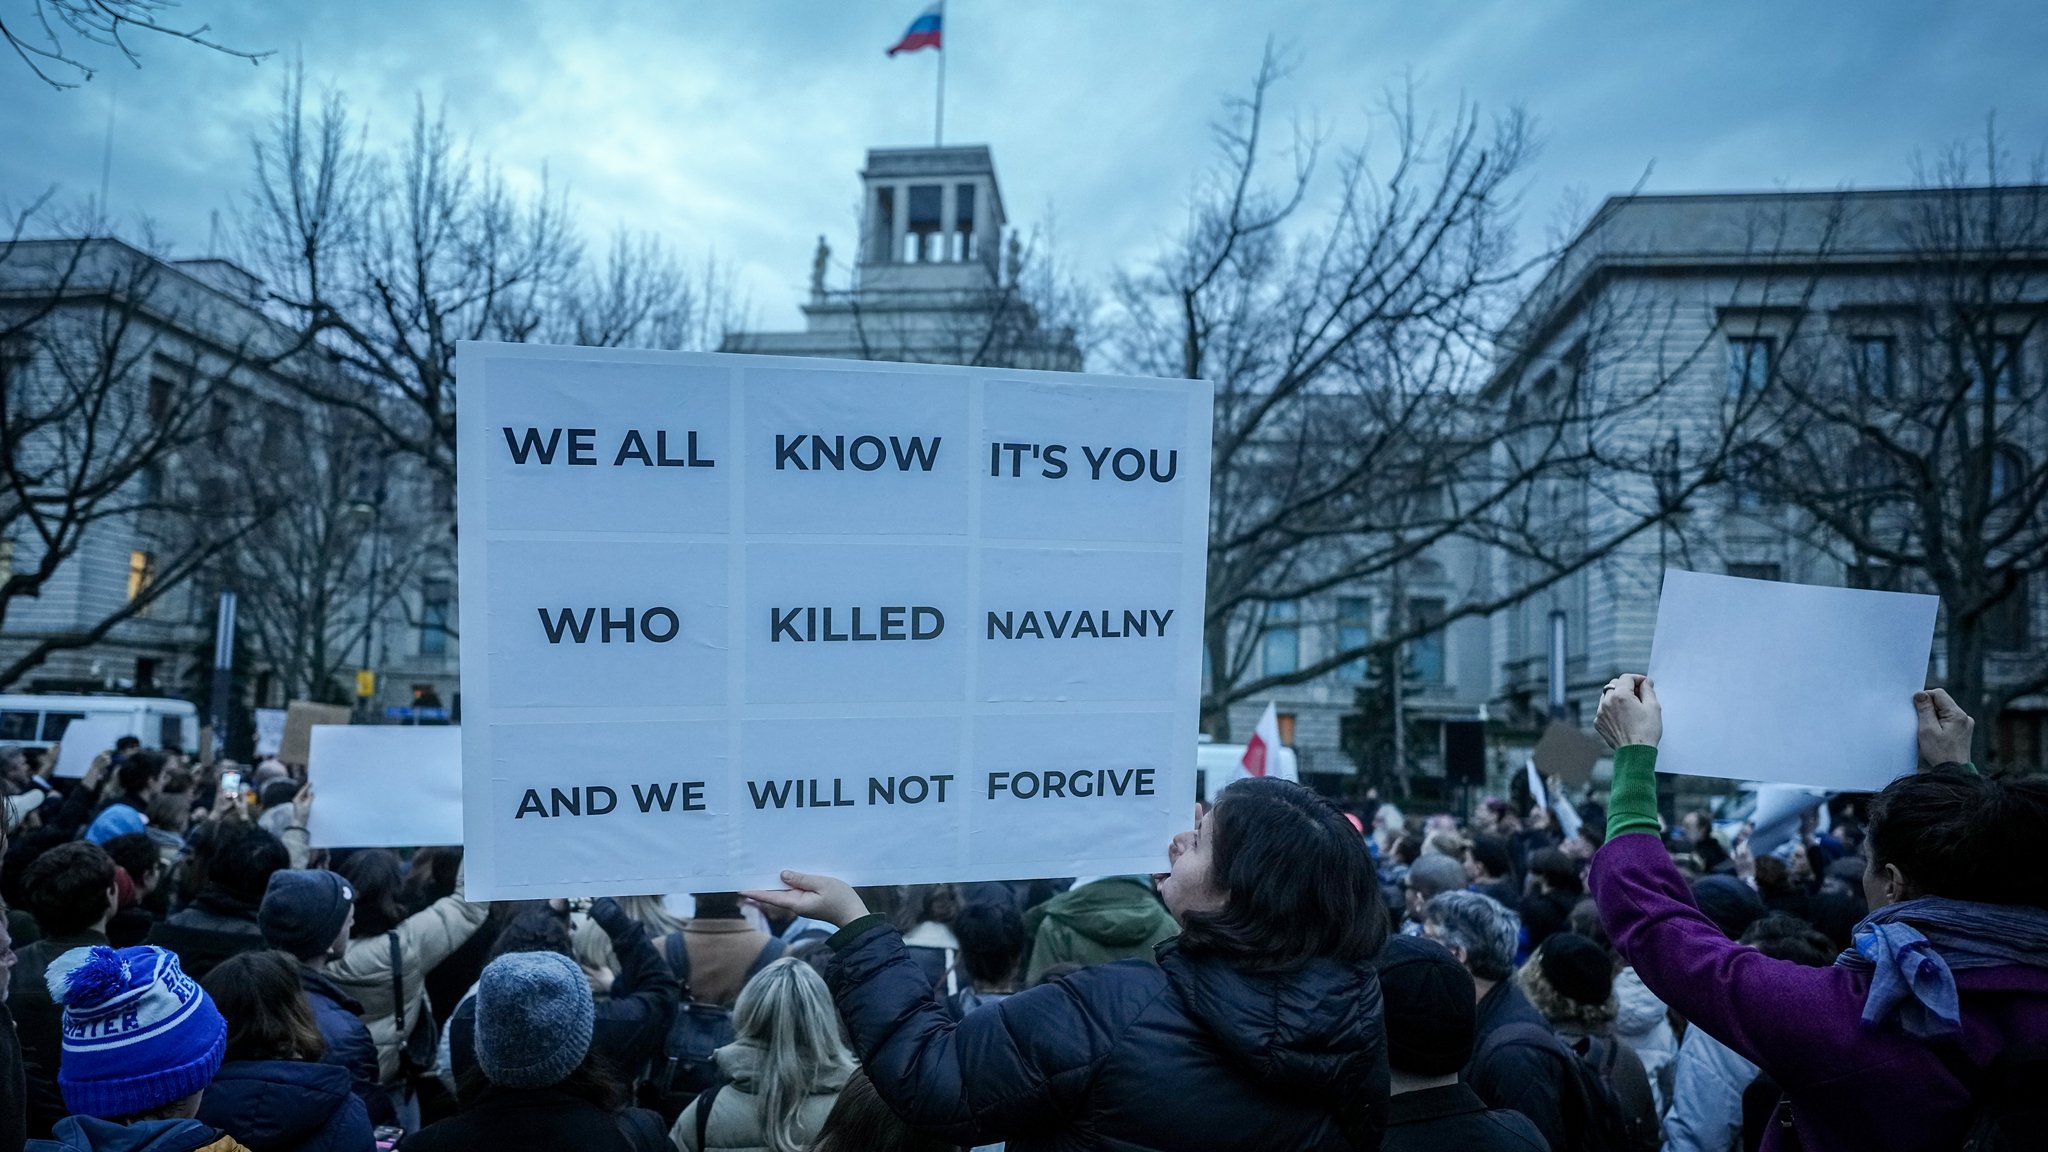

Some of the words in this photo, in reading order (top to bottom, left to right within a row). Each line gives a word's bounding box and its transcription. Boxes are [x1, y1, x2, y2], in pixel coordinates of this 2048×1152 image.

[502, 426, 598, 466] WE
[613, 429, 715, 468] ALL
[775, 434, 942, 472] KNOW
[990, 442, 1069, 480] IT'S
[1080, 445, 1178, 483] YOU
[537, 606, 680, 644] WHO
[771, 606, 945, 643] KILLED
[987, 609, 1175, 640] NAVALNY
[514, 786, 618, 820] AND
[630, 782, 706, 814] WE
[746, 778, 855, 810] WILL
[868, 774, 954, 806] NOT
[987, 768, 1156, 801] FORGIVE
